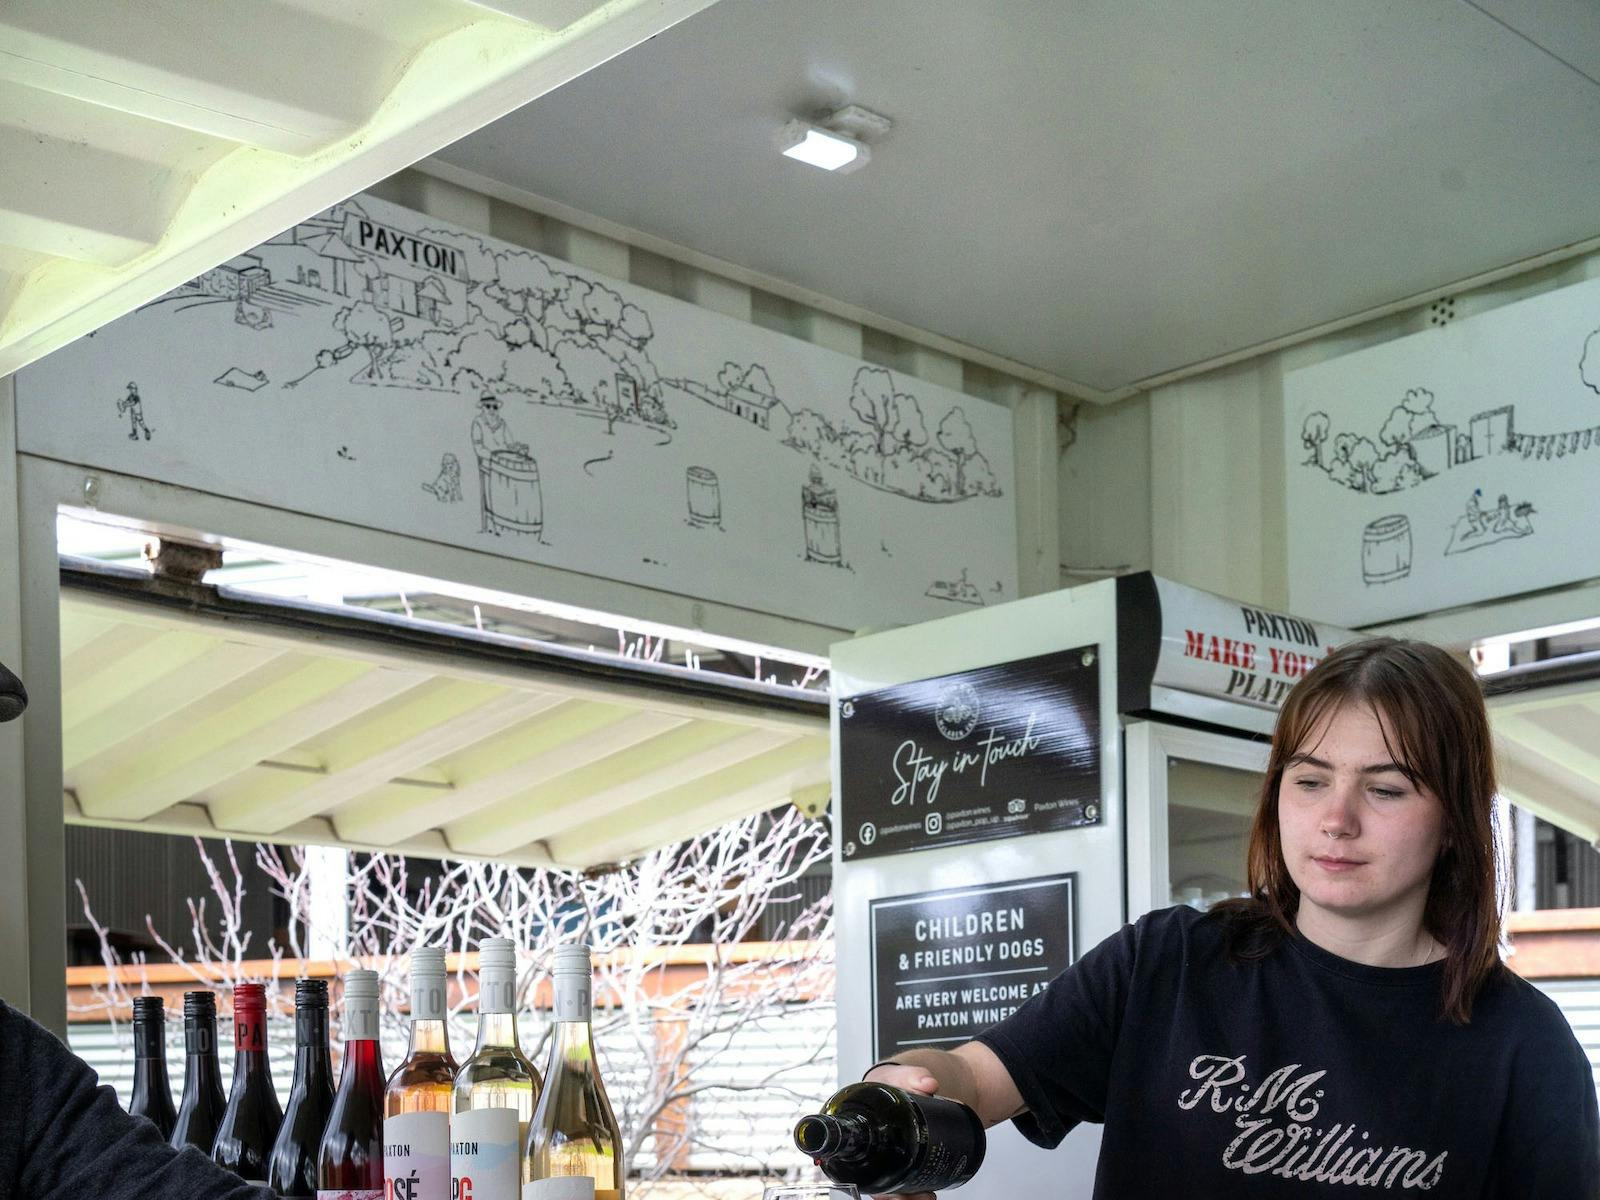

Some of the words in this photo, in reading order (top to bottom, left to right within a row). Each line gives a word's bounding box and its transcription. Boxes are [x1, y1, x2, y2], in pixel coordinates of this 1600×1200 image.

[359, 220, 456, 276] PAXTON
[1240, 606, 1320, 648] PAXTON
[1183, 629, 1257, 671] MAKE
[1268, 646, 1323, 678] YOU
[891, 739, 949, 806] Stay
[952, 750, 980, 774] in
[915, 907, 1024, 942] CHILDREN
[899, 953, 909, 970] &
[914, 943, 994, 969] FRIENDLY
[999, 938, 1044, 960] DOGS
[895, 994, 922, 1010] ARE
[924, 990, 958, 1007] VERY
[961, 983, 1028, 1005] WELCOME
[236, 1022, 263, 1047] PA
[918, 1010, 968, 1029] PAXTON
[384, 1144, 410, 1157] AXTON
[451, 1142, 478, 1155] AXTON
[1222, 1114, 1449, 1190] Williams
